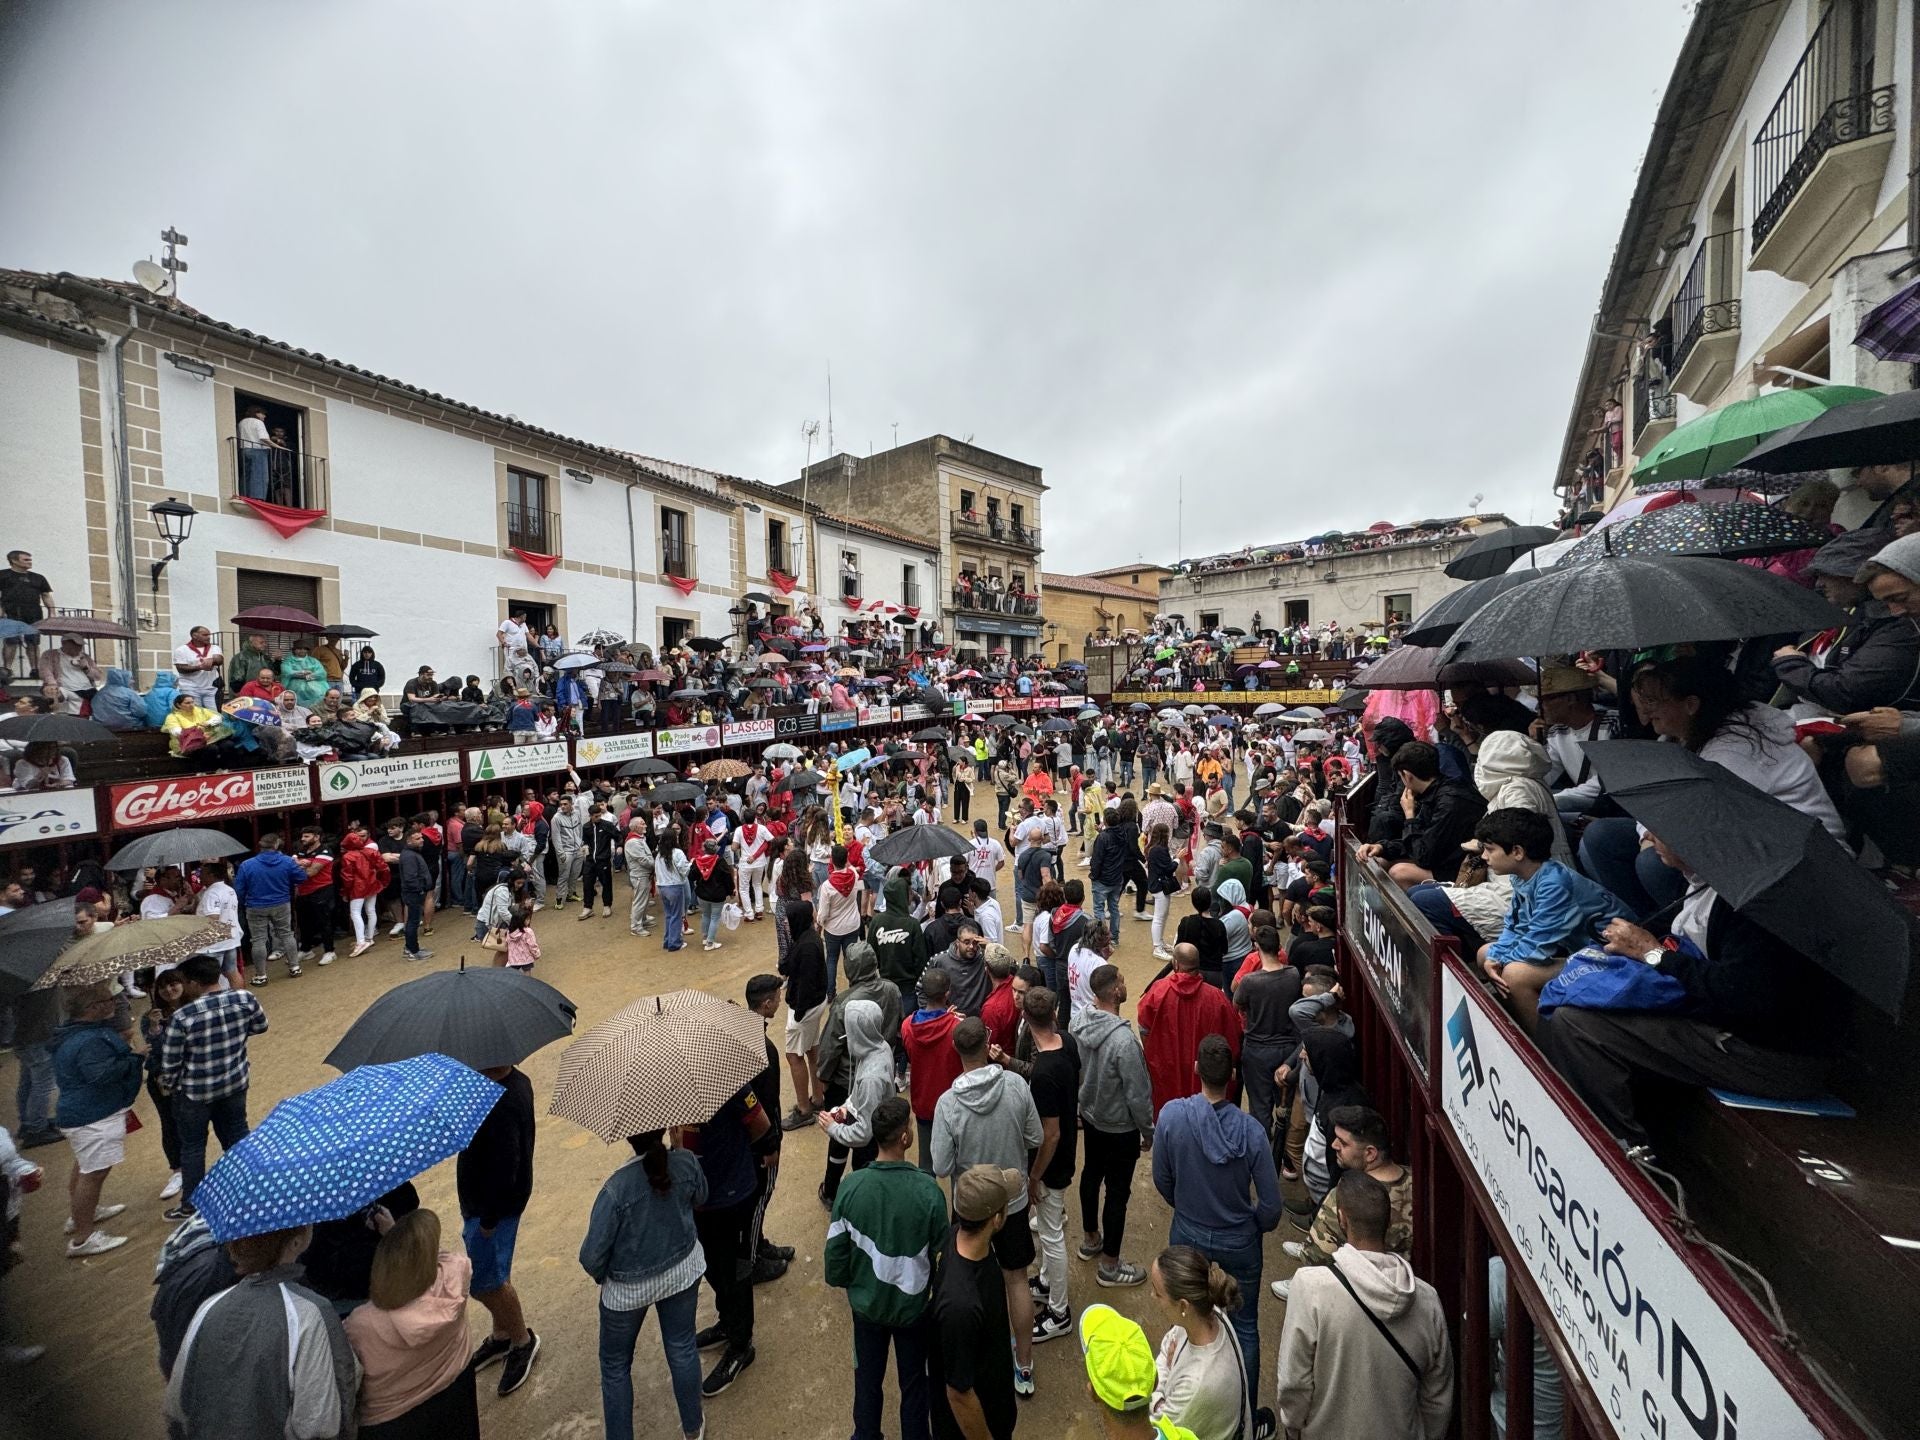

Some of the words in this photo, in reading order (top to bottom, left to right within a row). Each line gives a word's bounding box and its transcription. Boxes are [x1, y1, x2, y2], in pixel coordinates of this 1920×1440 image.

[723, 720, 774, 735] PLASCOR
[502, 744, 565, 760] ASAJA
[604, 743, 649, 753] EXTREMADURA
[360, 762, 409, 777] Joaquin
[413, 757, 459, 769] Herrero
[256, 779, 306, 791] INDUSTRIAL
[1364, 900, 1402, 998] EMISAN
[1448, 1097, 1478, 1160] Avenida
[1482, 1153, 1512, 1223] Virgen
[1516, 1223, 1533, 1261] de
[1539, 1261, 1600, 1380] Argeme
